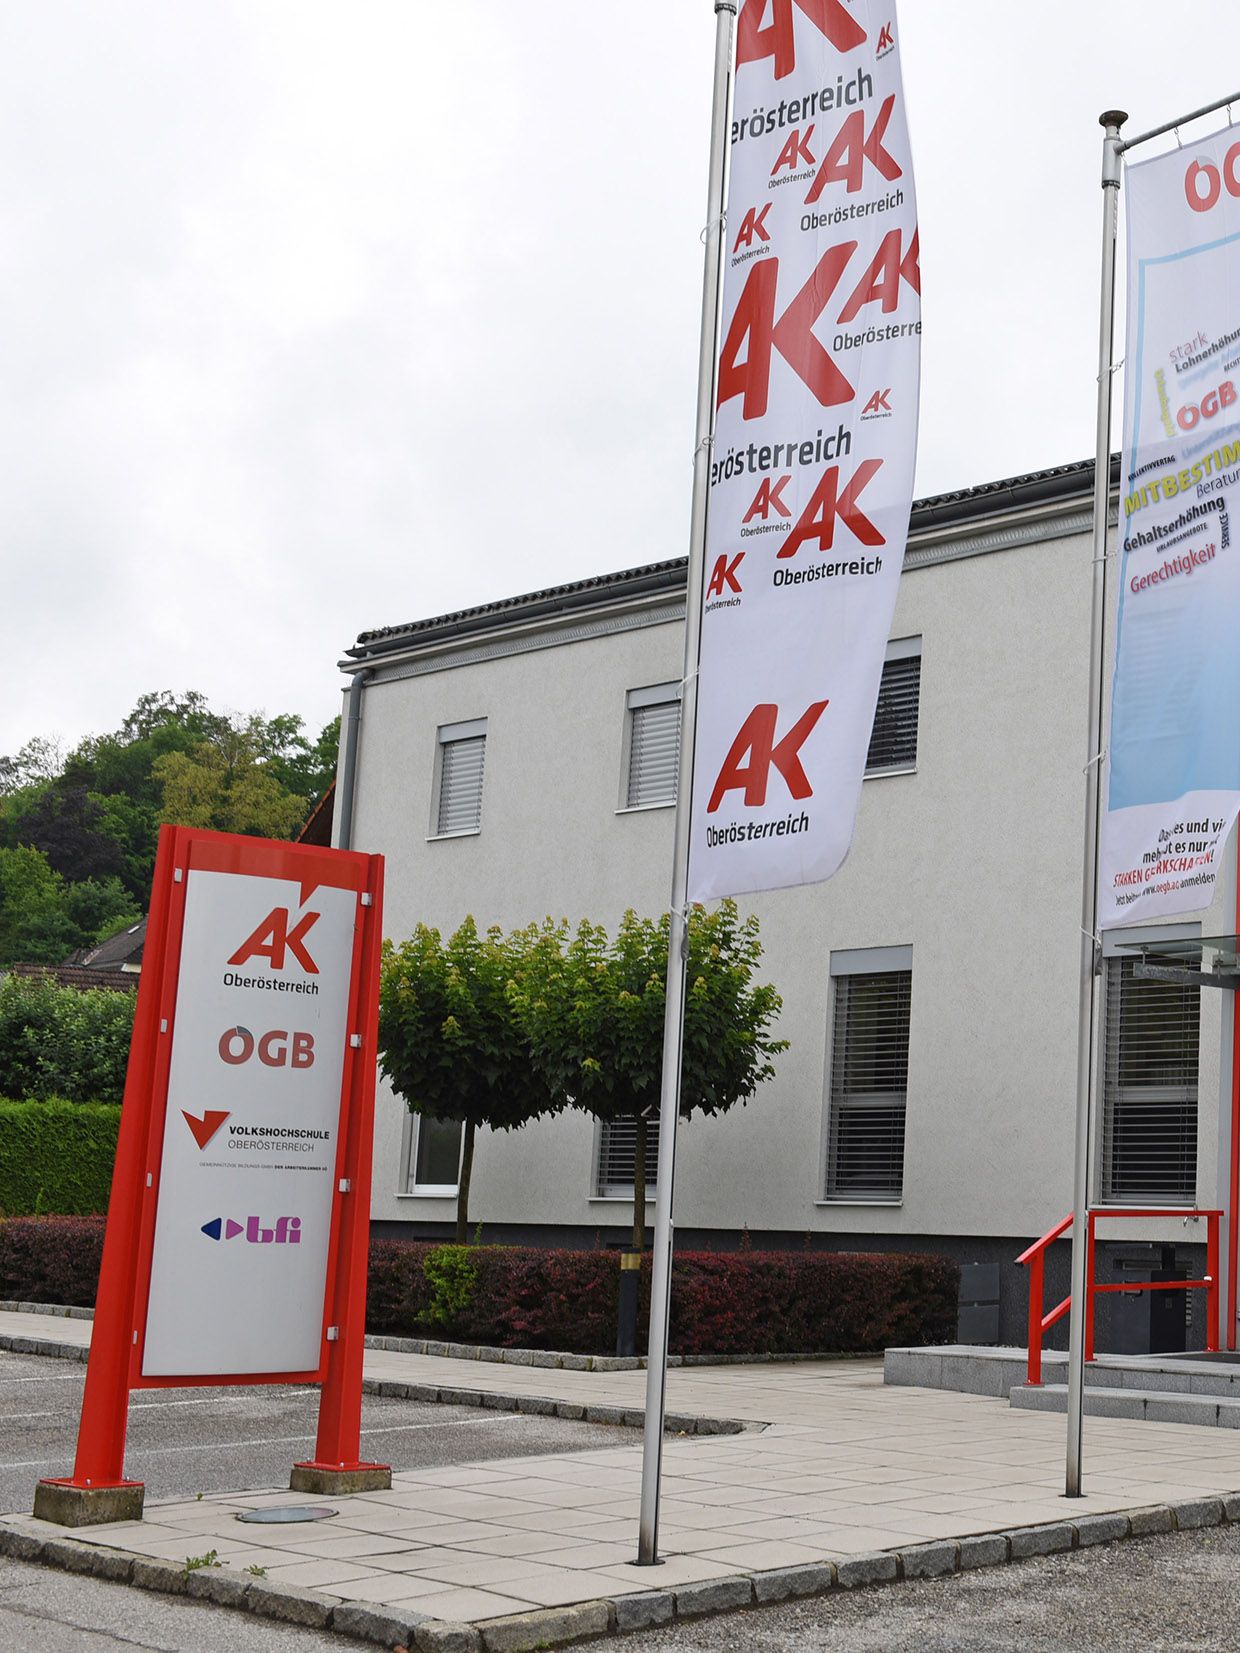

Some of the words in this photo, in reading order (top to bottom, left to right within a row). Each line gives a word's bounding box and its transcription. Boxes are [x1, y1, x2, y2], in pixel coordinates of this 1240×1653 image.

[876, 21, 894, 53] AK
[770, 123, 816, 176] AK
[804, 93, 903, 205] AK
[768, 168, 816, 189] Oberösterreich
[732, 201, 773, 254] AK
[800, 189, 904, 232] Oberösterreich
[716, 240, 859, 421] AK
[1169, 331, 1208, 363] stark
[861, 388, 892, 415] AK
[742, 475, 792, 524] AK
[776, 458, 887, 559] AK
[740, 521, 792, 538] Oberösterreich
[1123, 496, 1226, 553] Gehaltserhöhung
[706, 551, 746, 601] AK
[773, 556, 883, 587] Oberösterreich
[1130, 542, 1216, 595] Gerechtigkeit
[706, 699, 830, 813] AK
[706, 811, 809, 848] Oberösterreich
[1186, 818, 1209, 834] und
[1174, 841, 1186, 854] es
[1188, 841, 1208, 853] nur
[1180, 872, 1216, 889] anmelden
[227, 907, 321, 974] AK
[223, 972, 319, 995] Oberösterreich
[228, 1139, 315, 1152] OBERÖSTERREICH
[229, 1126, 330, 1140] VOLKSHOCHSCHULE
[246, 1216, 301, 1243] bfi
